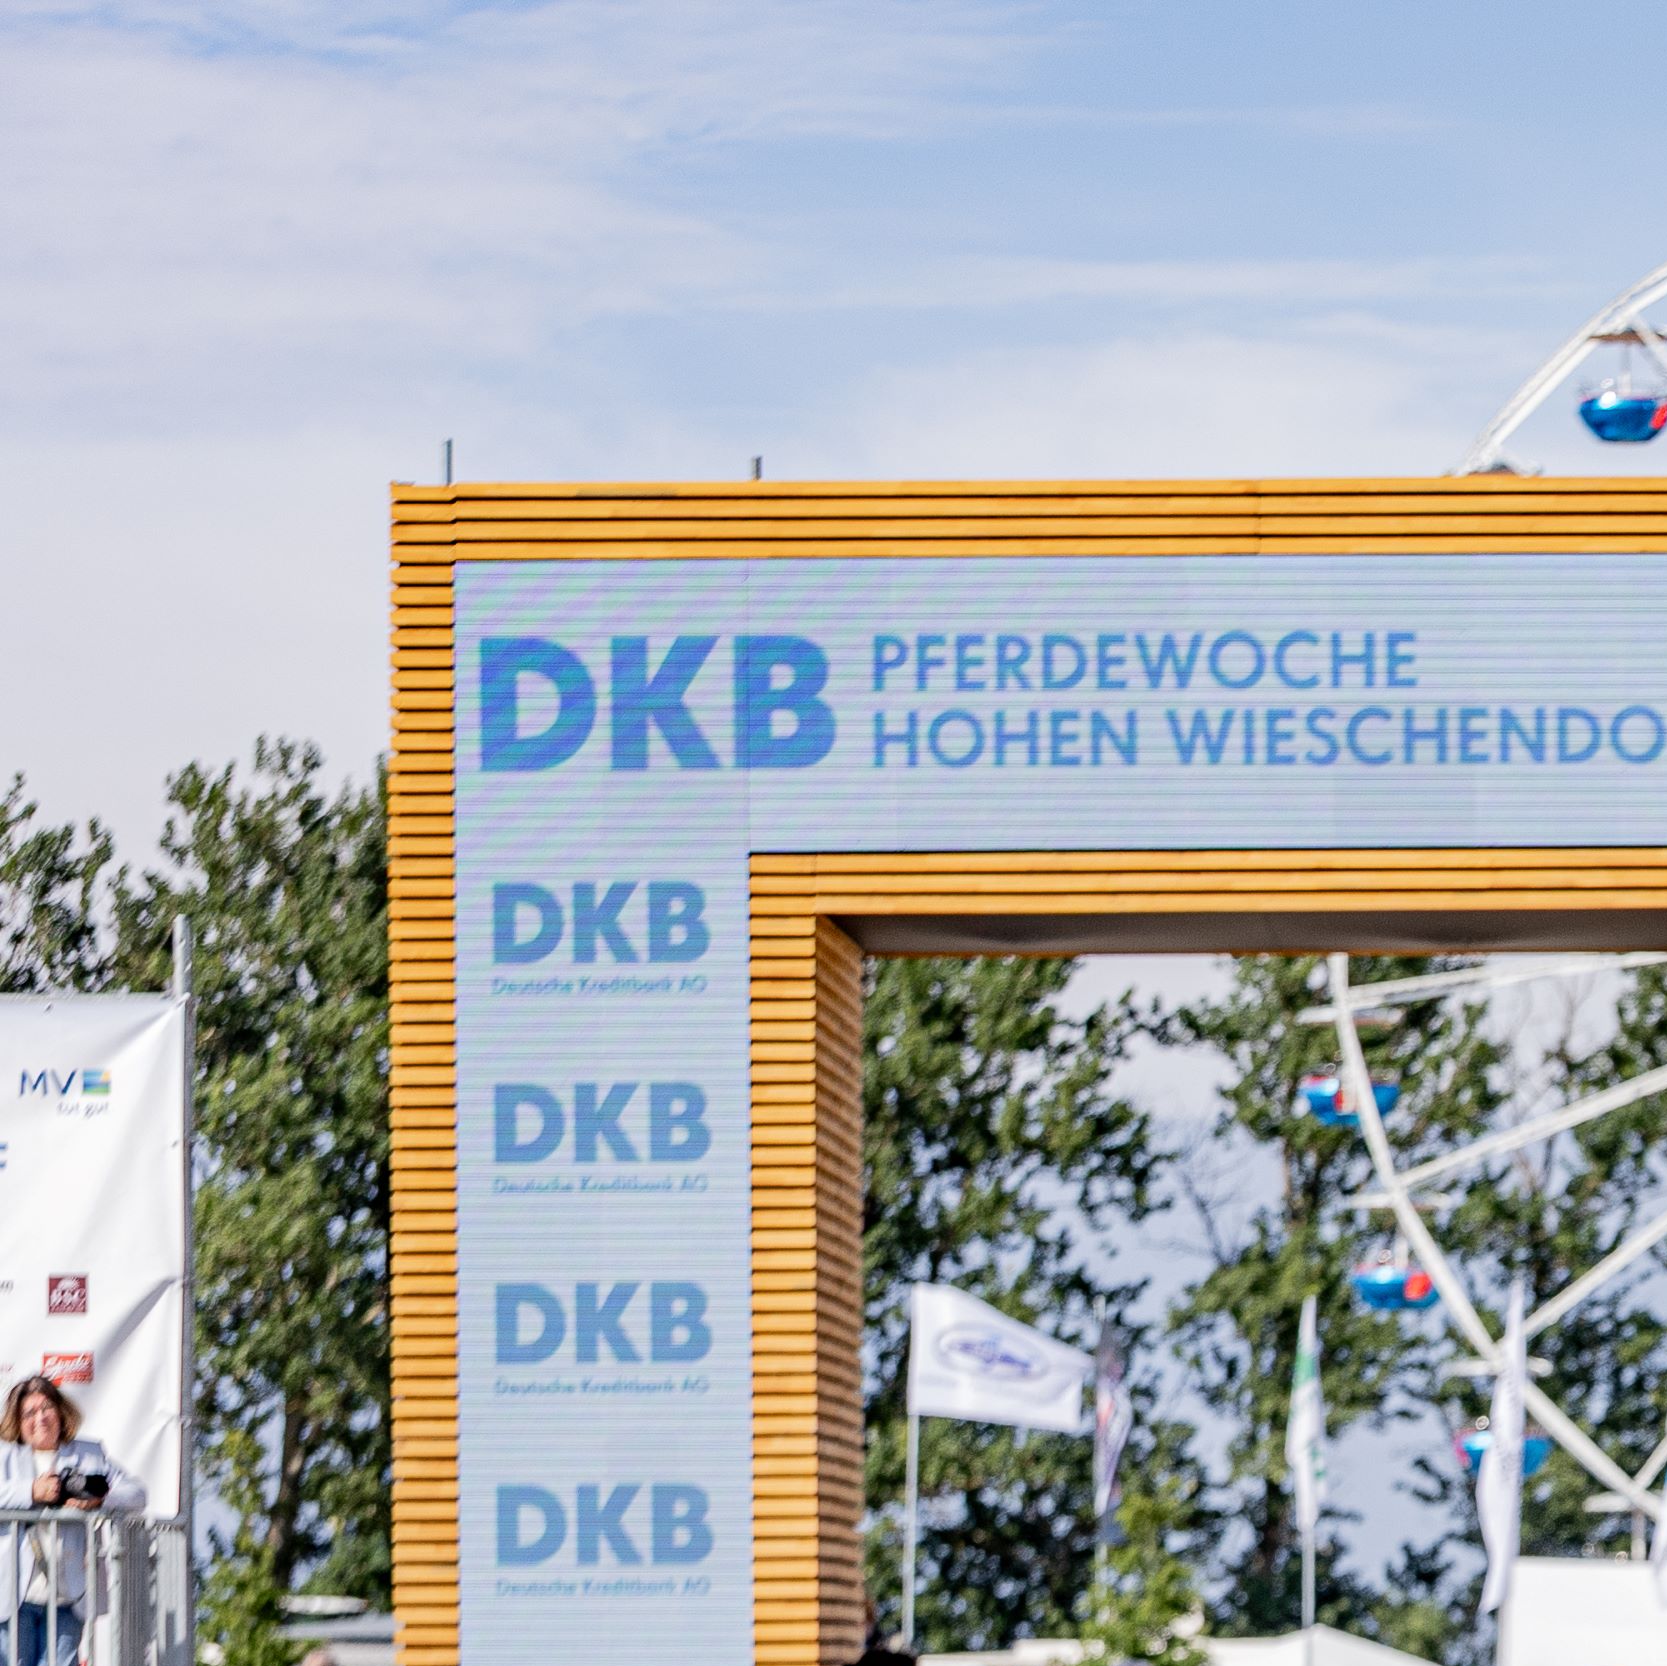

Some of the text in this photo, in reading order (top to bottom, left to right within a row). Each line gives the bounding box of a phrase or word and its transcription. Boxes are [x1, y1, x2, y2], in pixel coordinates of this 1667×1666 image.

[870, 629, 1418, 692] PFERDEWOCHE
[478, 634, 837, 773] DKB
[871, 706, 1139, 769] HOHEN
[492, 881, 712, 965] DKB
[19, 1068, 78, 1098] MV
[492, 1081, 713, 1164] DKB
[495, 1281, 714, 1365] DKB
[495, 1482, 715, 1567] DKB
